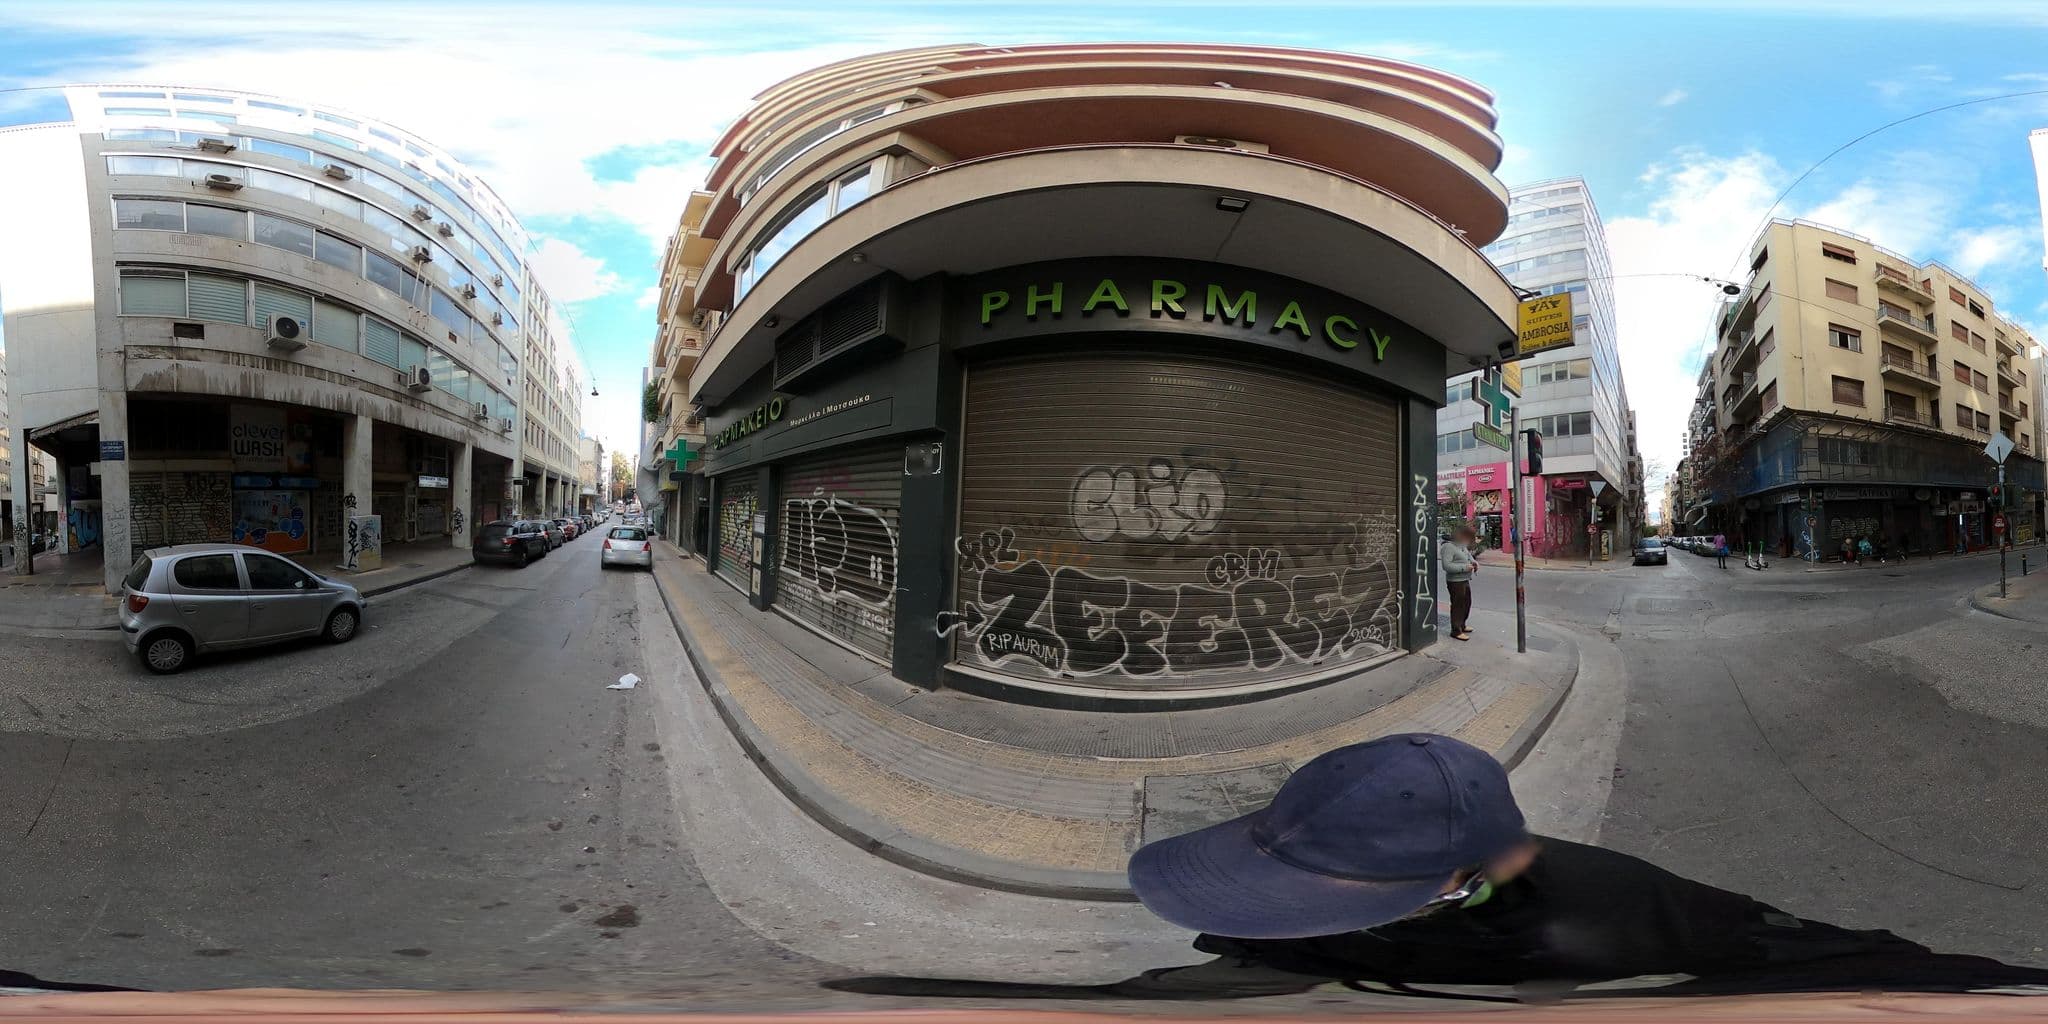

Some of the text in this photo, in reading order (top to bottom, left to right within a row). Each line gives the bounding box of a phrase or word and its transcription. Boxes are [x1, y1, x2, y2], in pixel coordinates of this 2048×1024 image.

[980, 278, 1391, 362] PHARMACY
[1521, 321, 1570, 342] AMBROSIA
[232, 423, 285, 440] clever
[713, 396, 784, 450] ΦΑΡΜΑΚΕΙΟ
[234, 440, 285, 457] WASH
[1205, 548, 1281, 589] CBM
[987, 632, 1059, 668] RIP AURUM
